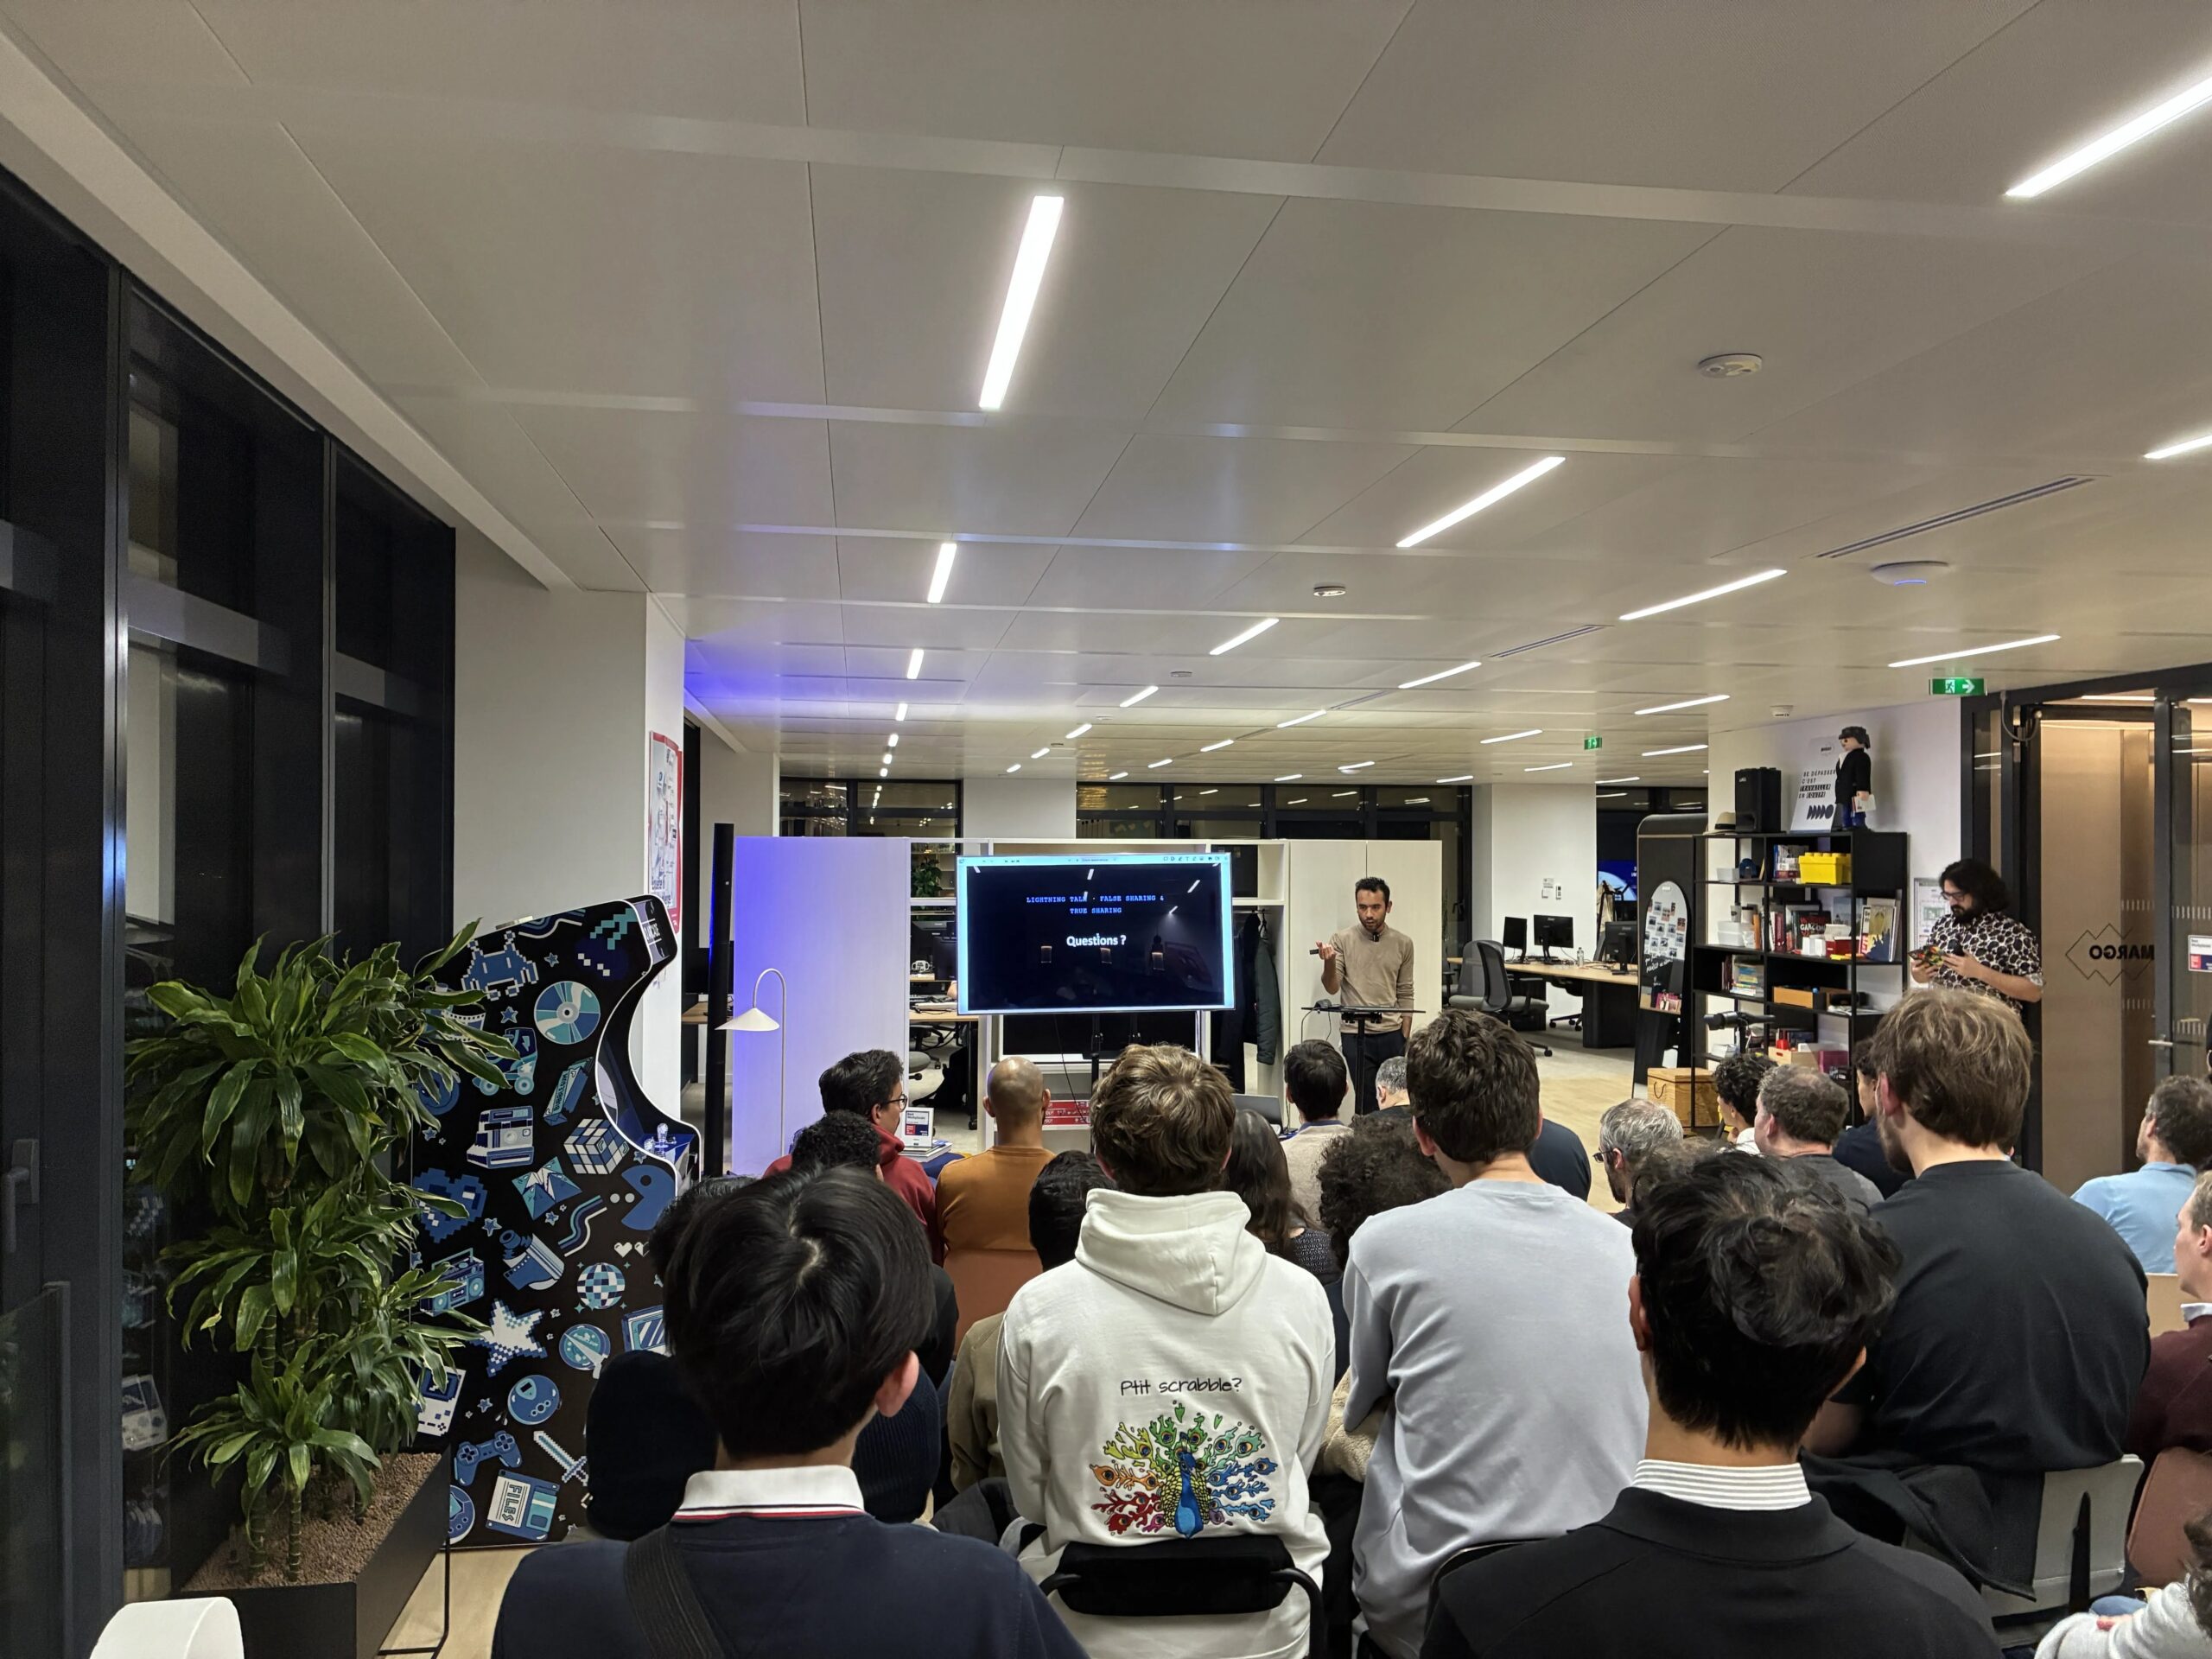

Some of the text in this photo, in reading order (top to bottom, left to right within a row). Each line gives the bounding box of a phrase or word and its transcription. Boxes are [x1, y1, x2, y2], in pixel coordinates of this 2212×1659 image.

[1066, 933, 1118, 947] Questions
[1159, 1377, 1243, 1394] scrabble?
[502, 1484, 522, 1522] FILES
